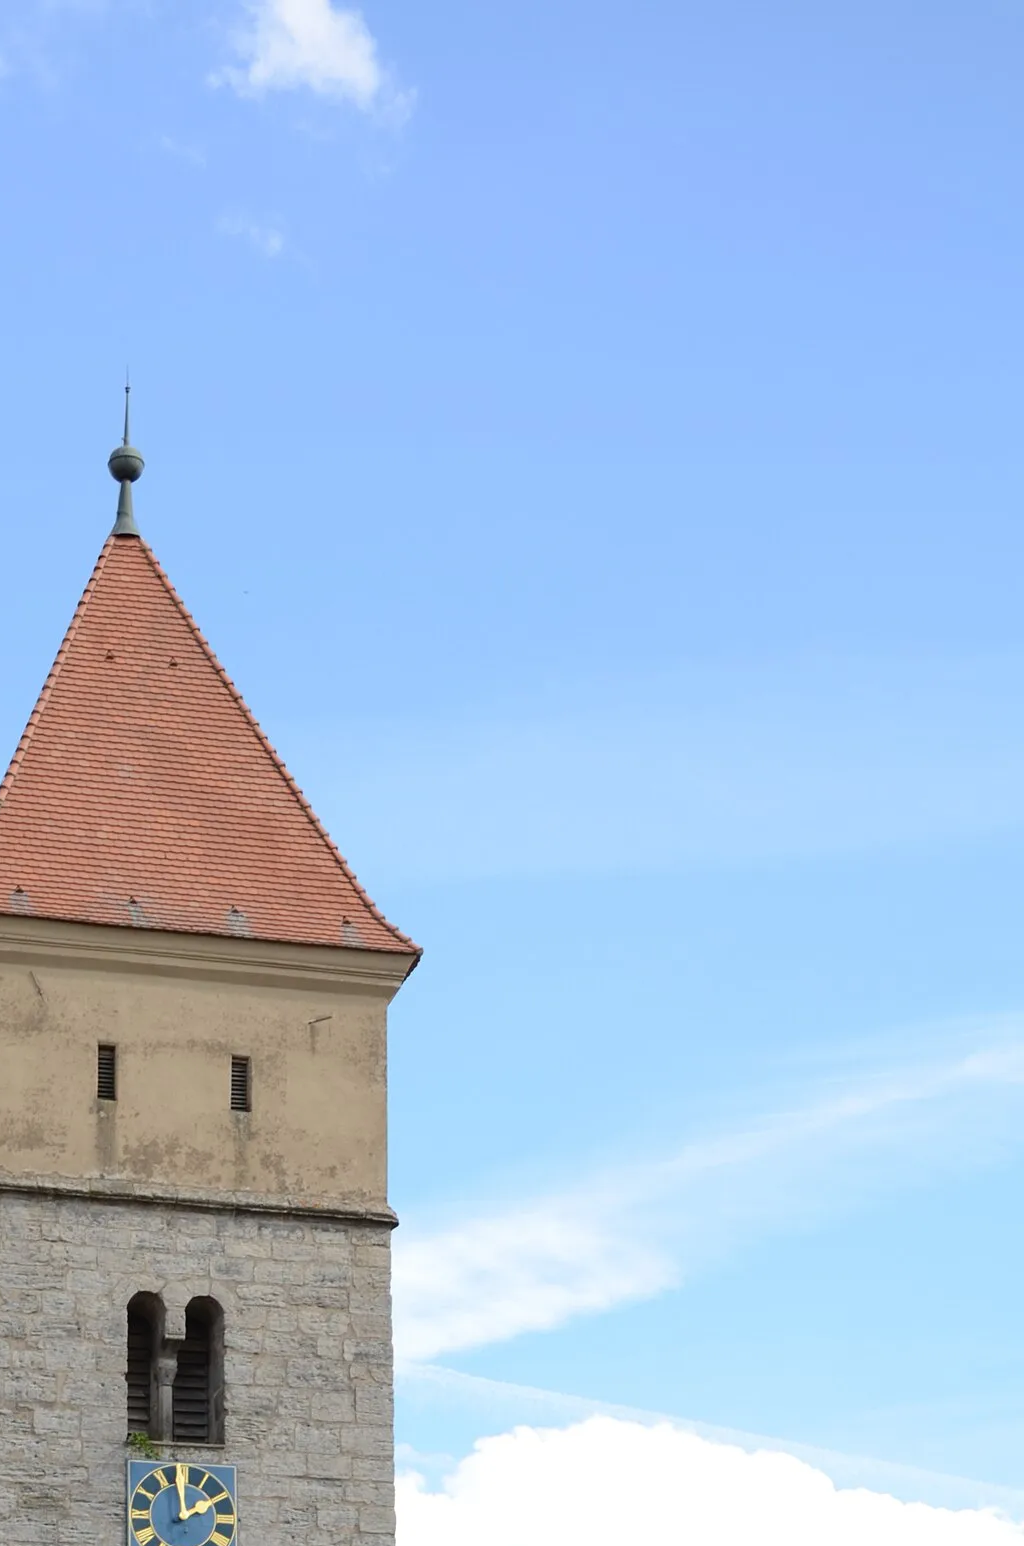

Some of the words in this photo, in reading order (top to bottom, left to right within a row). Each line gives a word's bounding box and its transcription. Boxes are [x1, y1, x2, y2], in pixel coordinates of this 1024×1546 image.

[199, 1472, 210, 1489] I
[137, 1486, 154, 1500] X
[131, 1509, 150, 1519] IX
[216, 1514, 234, 1524] III
